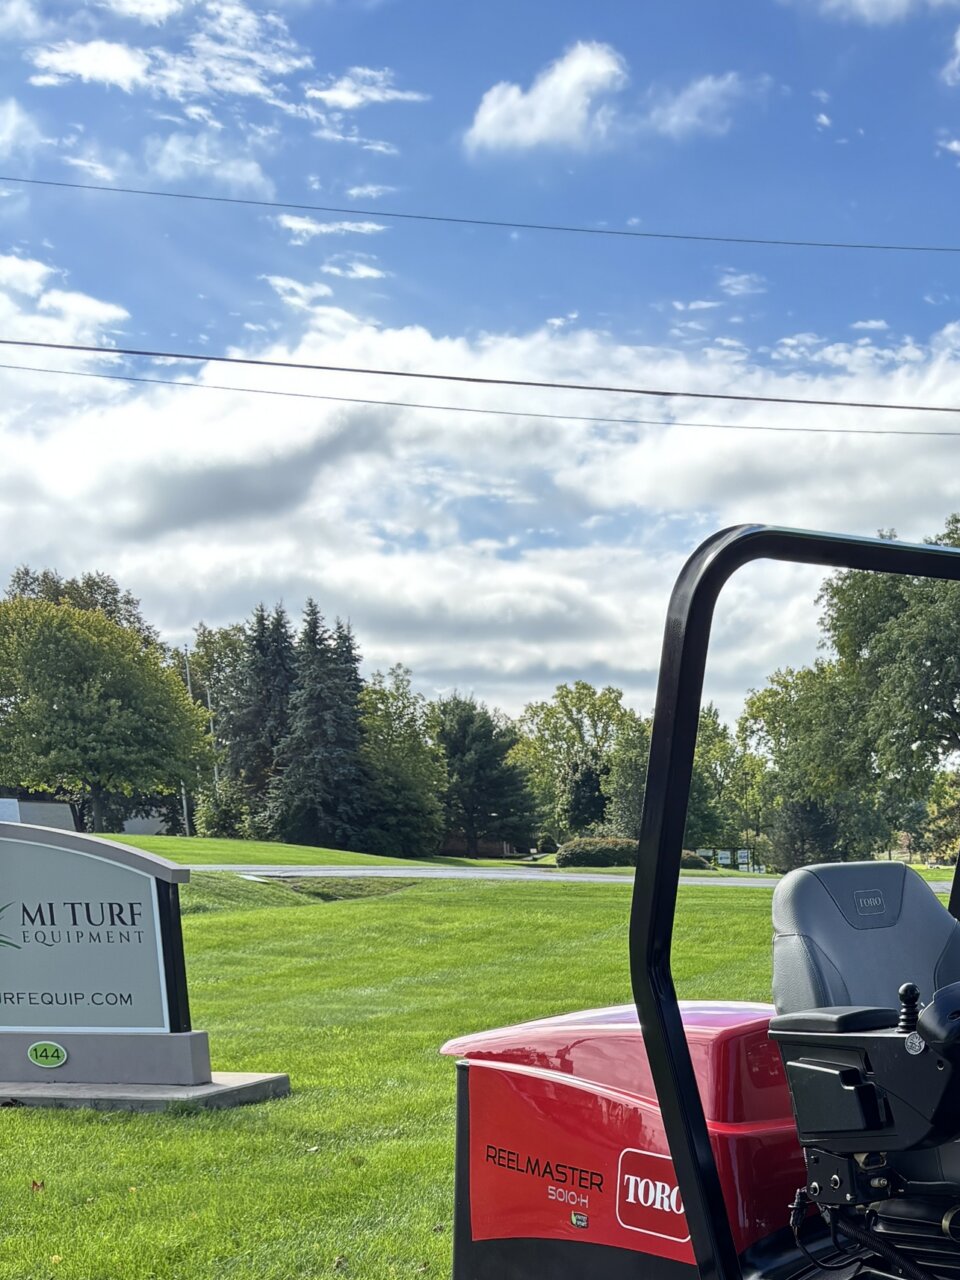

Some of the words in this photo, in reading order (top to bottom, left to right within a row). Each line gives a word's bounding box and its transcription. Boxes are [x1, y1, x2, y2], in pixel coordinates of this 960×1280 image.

[858, 896, 882, 908] TORO
[21, 902, 55, 926] MI
[63, 902, 142, 926] TURF
[22, 930, 144, 947] EQUIPMENT
[0, 992, 133, 1006] RFEQUIP.COM
[32, 1047, 61, 1061] 144
[485, 1145, 604, 1193] REELMASTER
